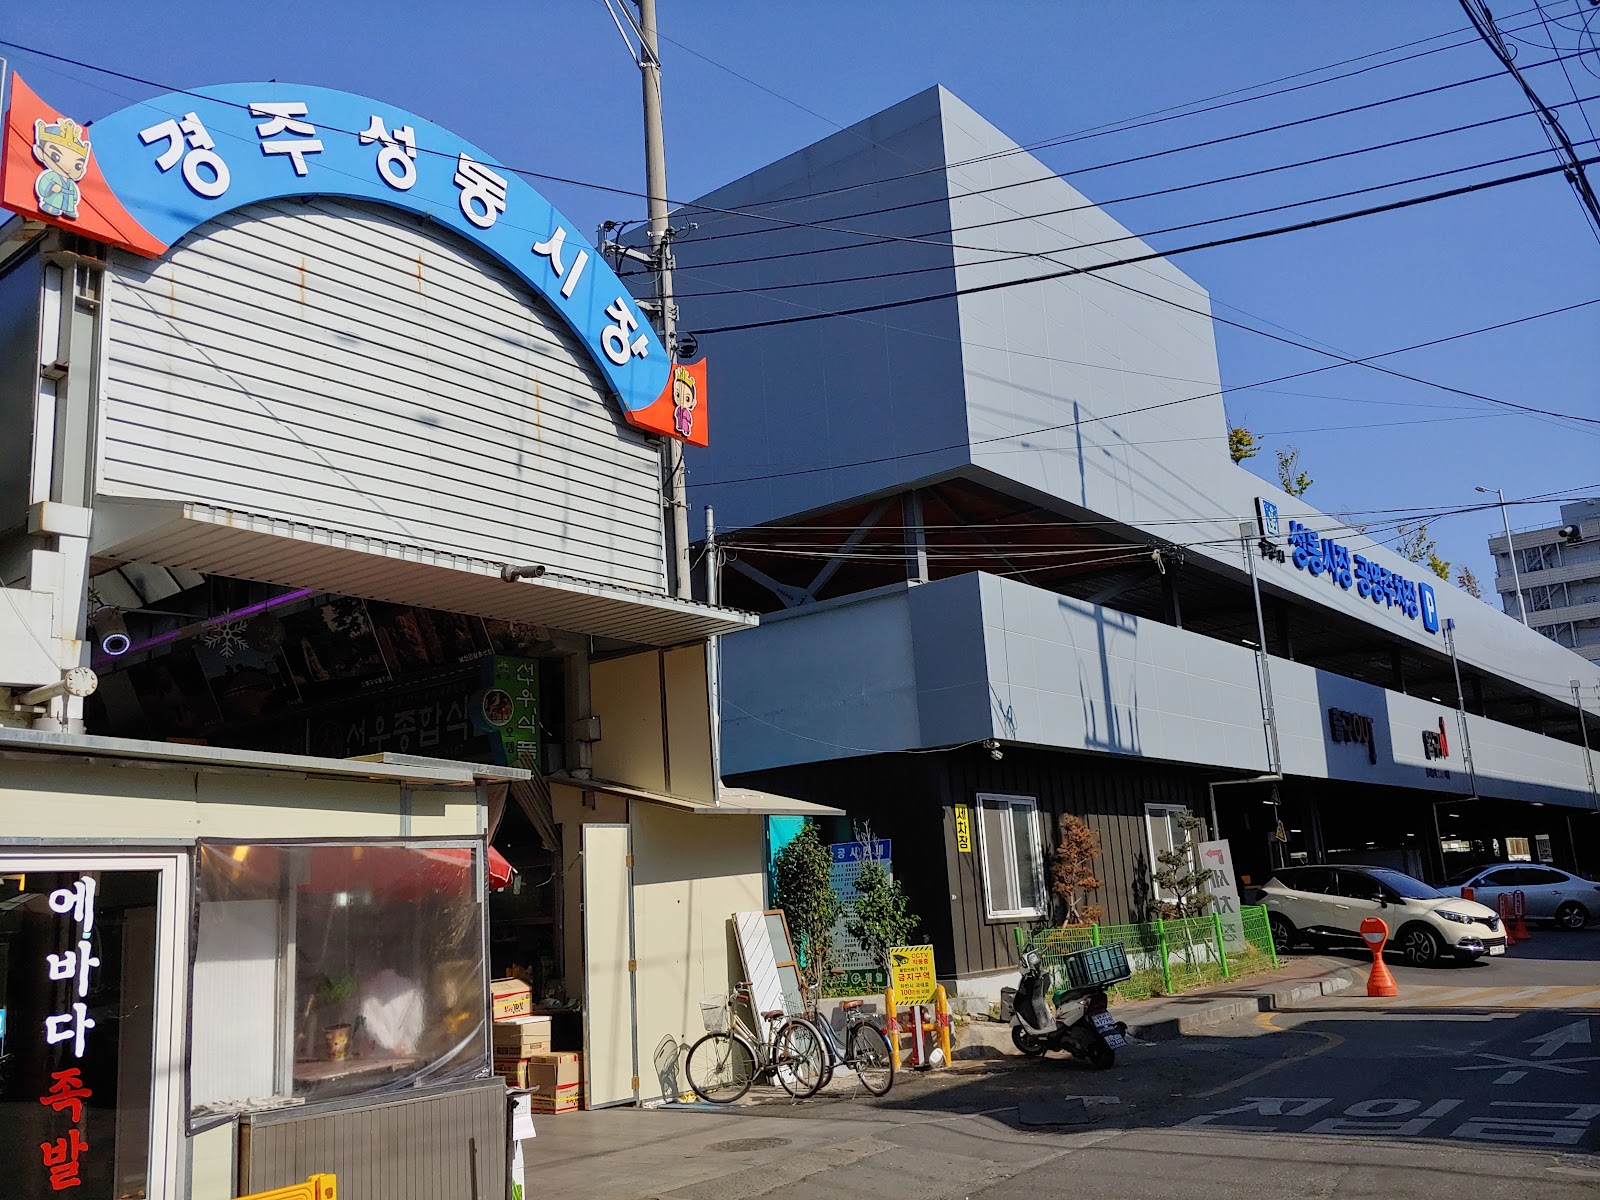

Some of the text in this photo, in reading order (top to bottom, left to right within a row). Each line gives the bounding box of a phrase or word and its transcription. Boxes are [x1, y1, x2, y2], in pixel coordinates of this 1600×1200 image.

[139, 101, 650, 365] 경주성동시장
[1288, 519, 1435, 623] 성동시장 공영주차장 P
[956, 805, 968, 849] 세차장
[898, 971, 930, 982] 금지구역
[40, 876, 100, 1191] 에바다 족발
